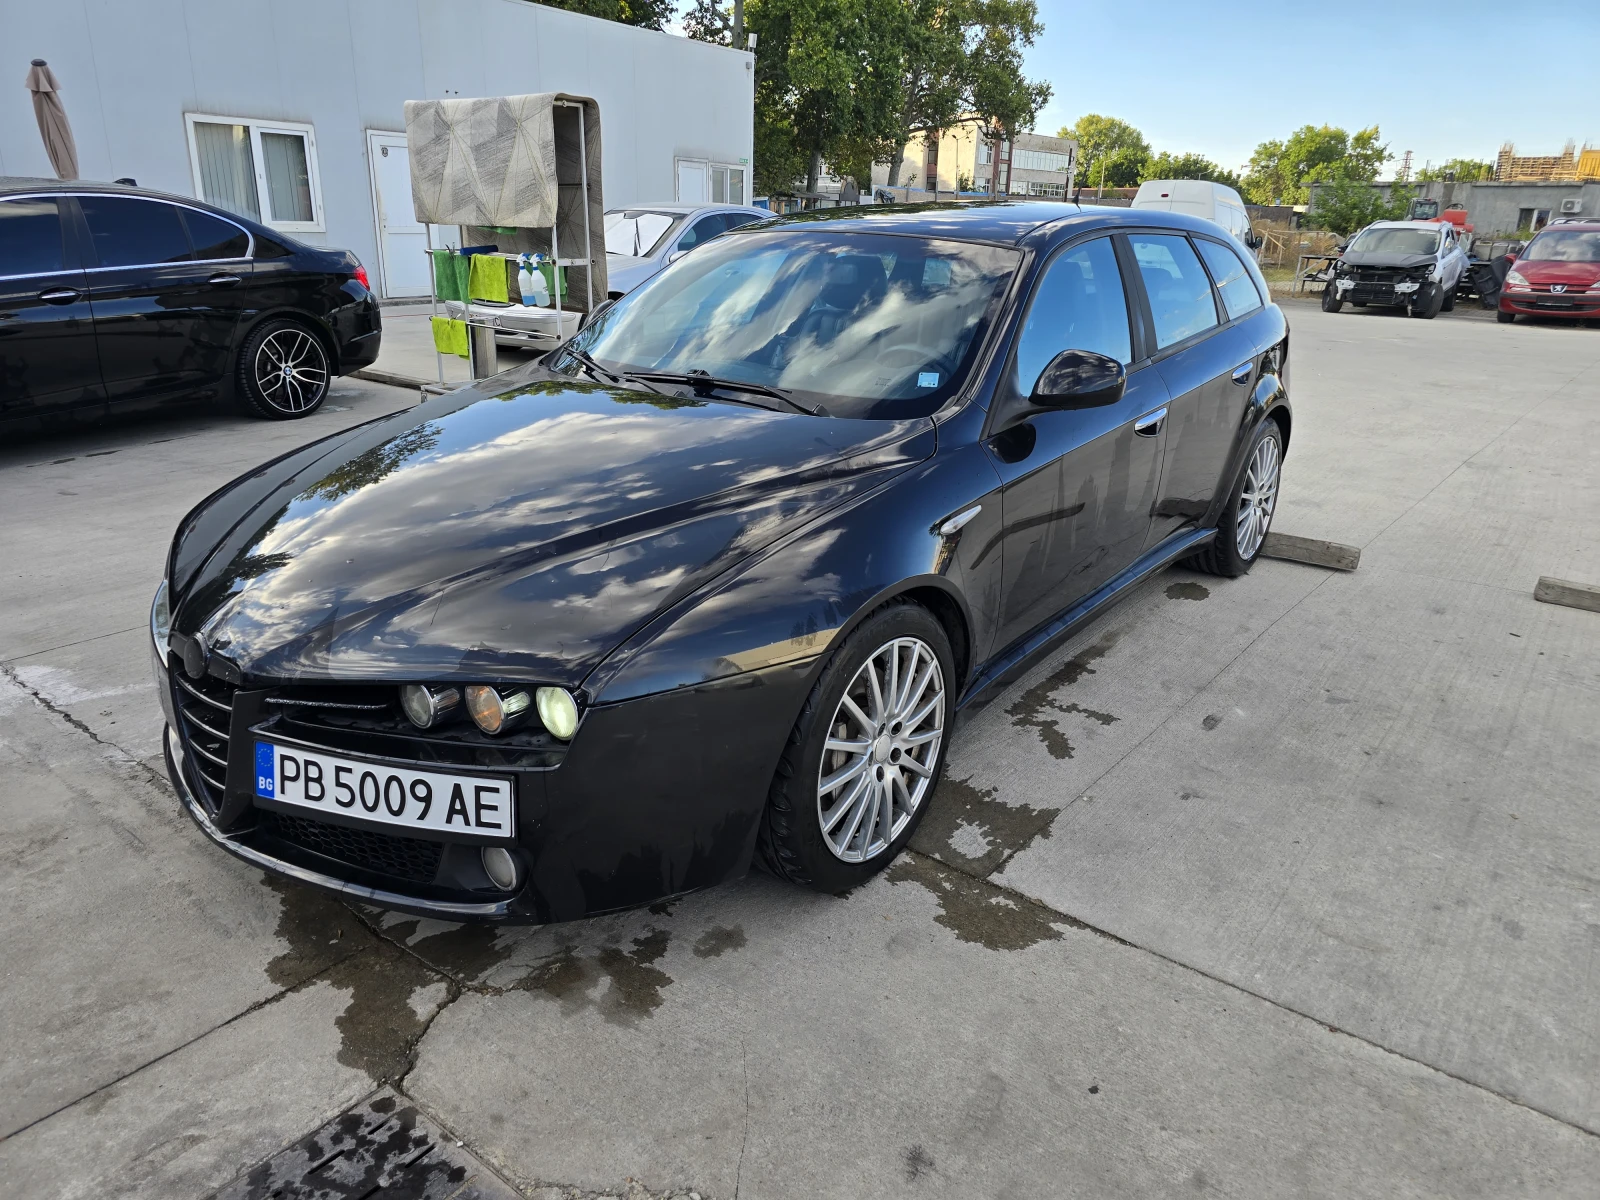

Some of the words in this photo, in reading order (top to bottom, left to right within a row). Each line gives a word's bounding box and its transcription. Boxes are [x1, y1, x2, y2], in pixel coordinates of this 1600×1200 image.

[258, 776, 273, 791] BG
[280, 754, 325, 801] PB
[334, 765, 433, 820] 5009
[445, 782, 502, 829] AE
